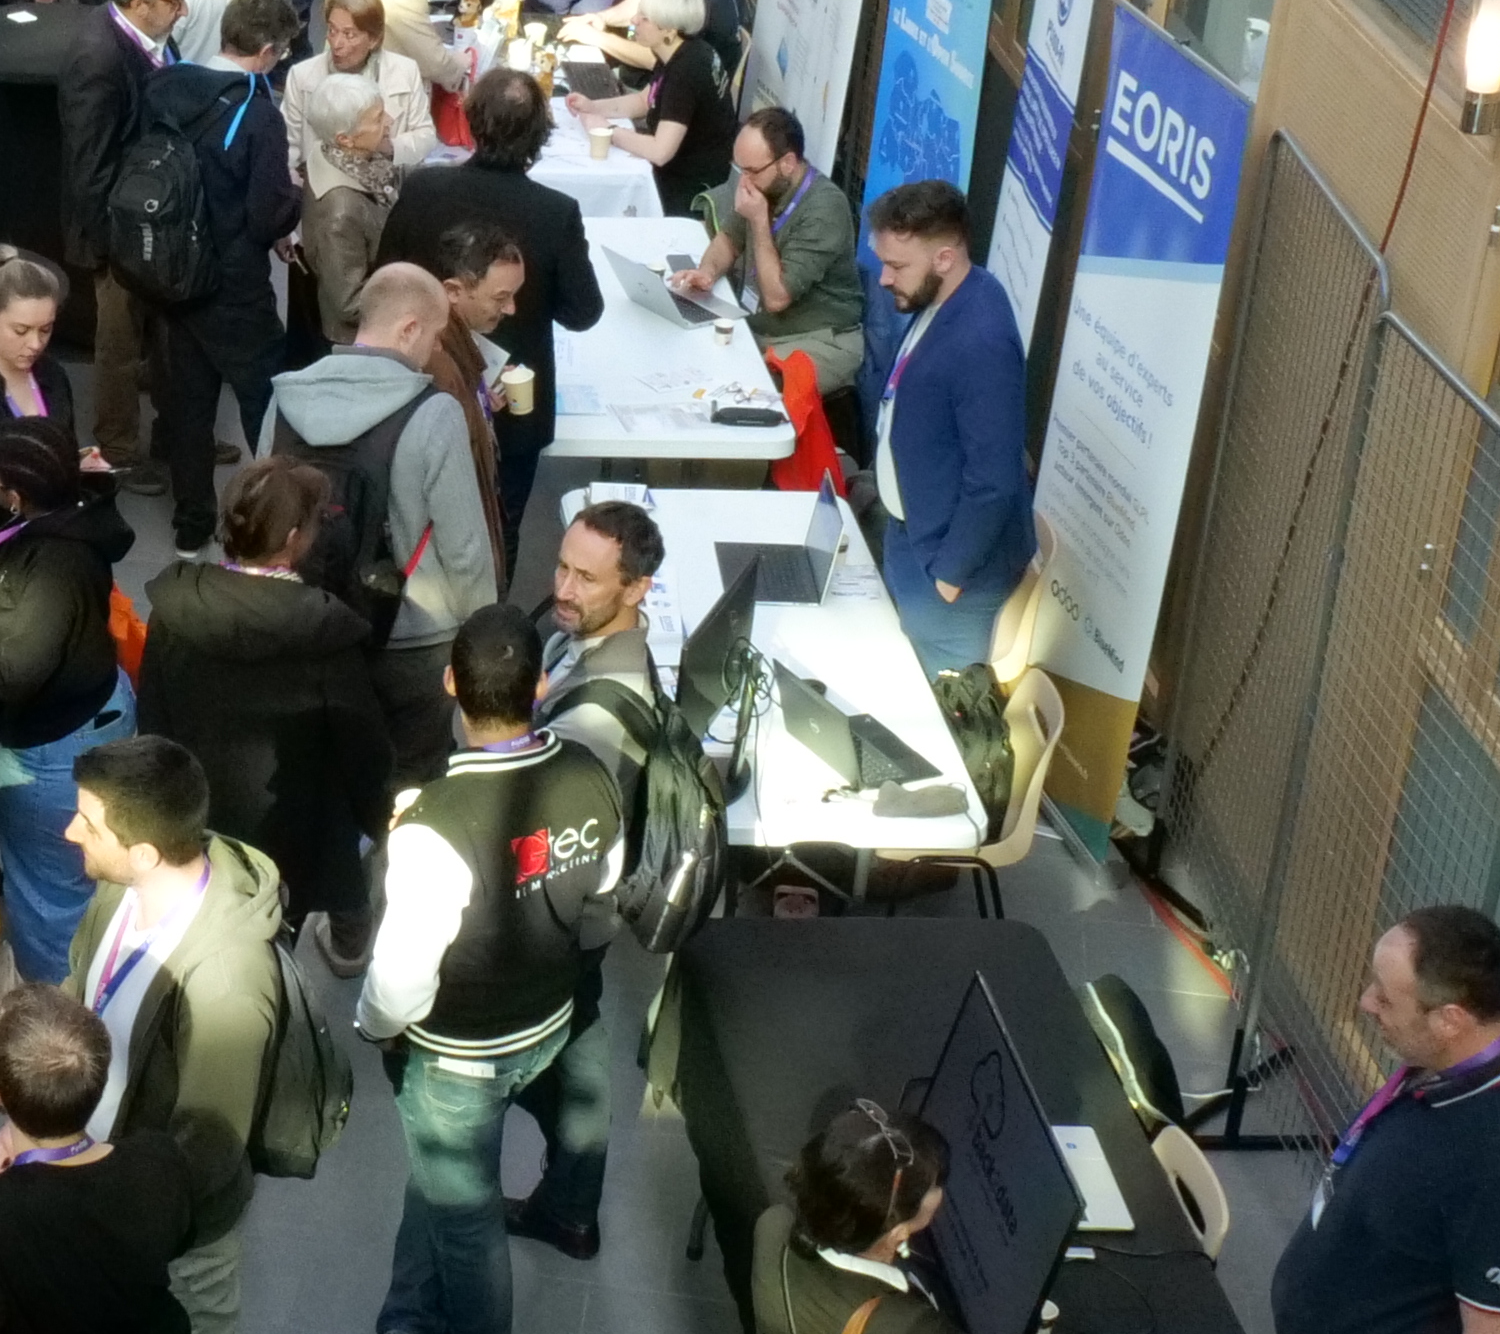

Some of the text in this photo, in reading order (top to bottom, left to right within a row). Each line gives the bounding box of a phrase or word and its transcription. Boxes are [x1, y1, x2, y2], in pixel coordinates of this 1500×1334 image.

[1110, 69, 1217, 200] EORIS
[1073, 293, 1093, 329] Une
[1093, 315, 1128, 359] équipe
[1071, 360, 1087, 381] de
[1086, 374, 1106, 401] vos
[1094, 349, 1145, 409] au service
[1051, 578, 1080, 621] odoo
